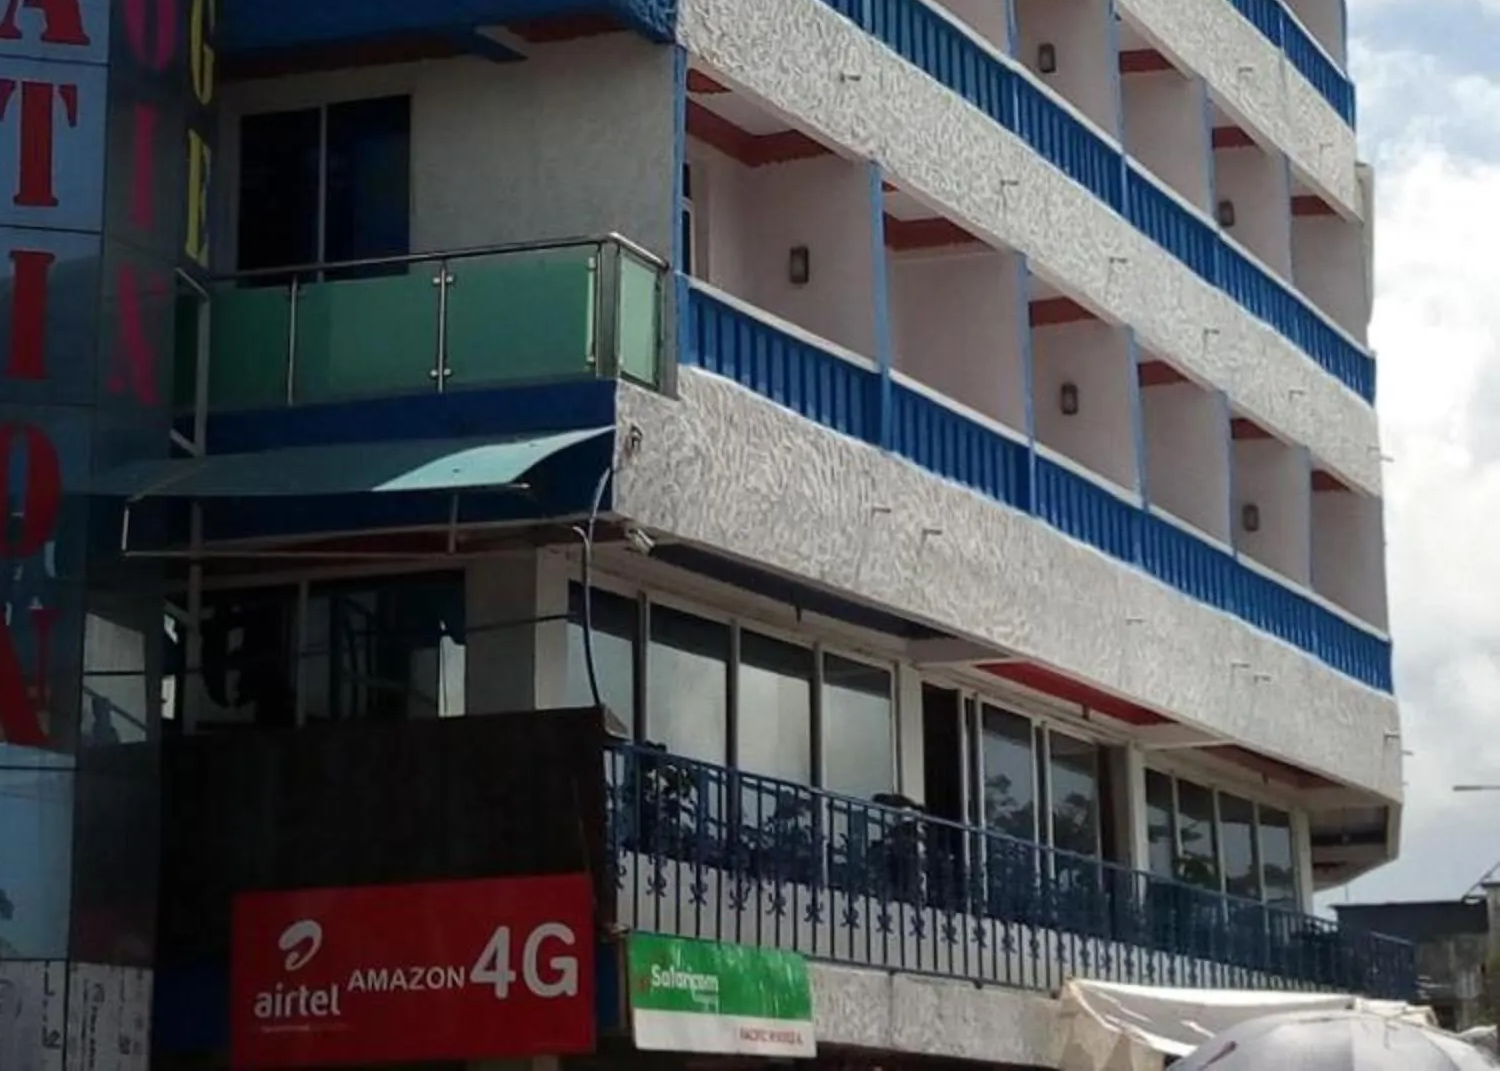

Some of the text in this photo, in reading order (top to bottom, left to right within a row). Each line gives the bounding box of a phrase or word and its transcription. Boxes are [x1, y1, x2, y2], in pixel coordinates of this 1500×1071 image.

[347, 922, 579, 1000] AMAZON 4G
[254, 982, 341, 1018] airtel
